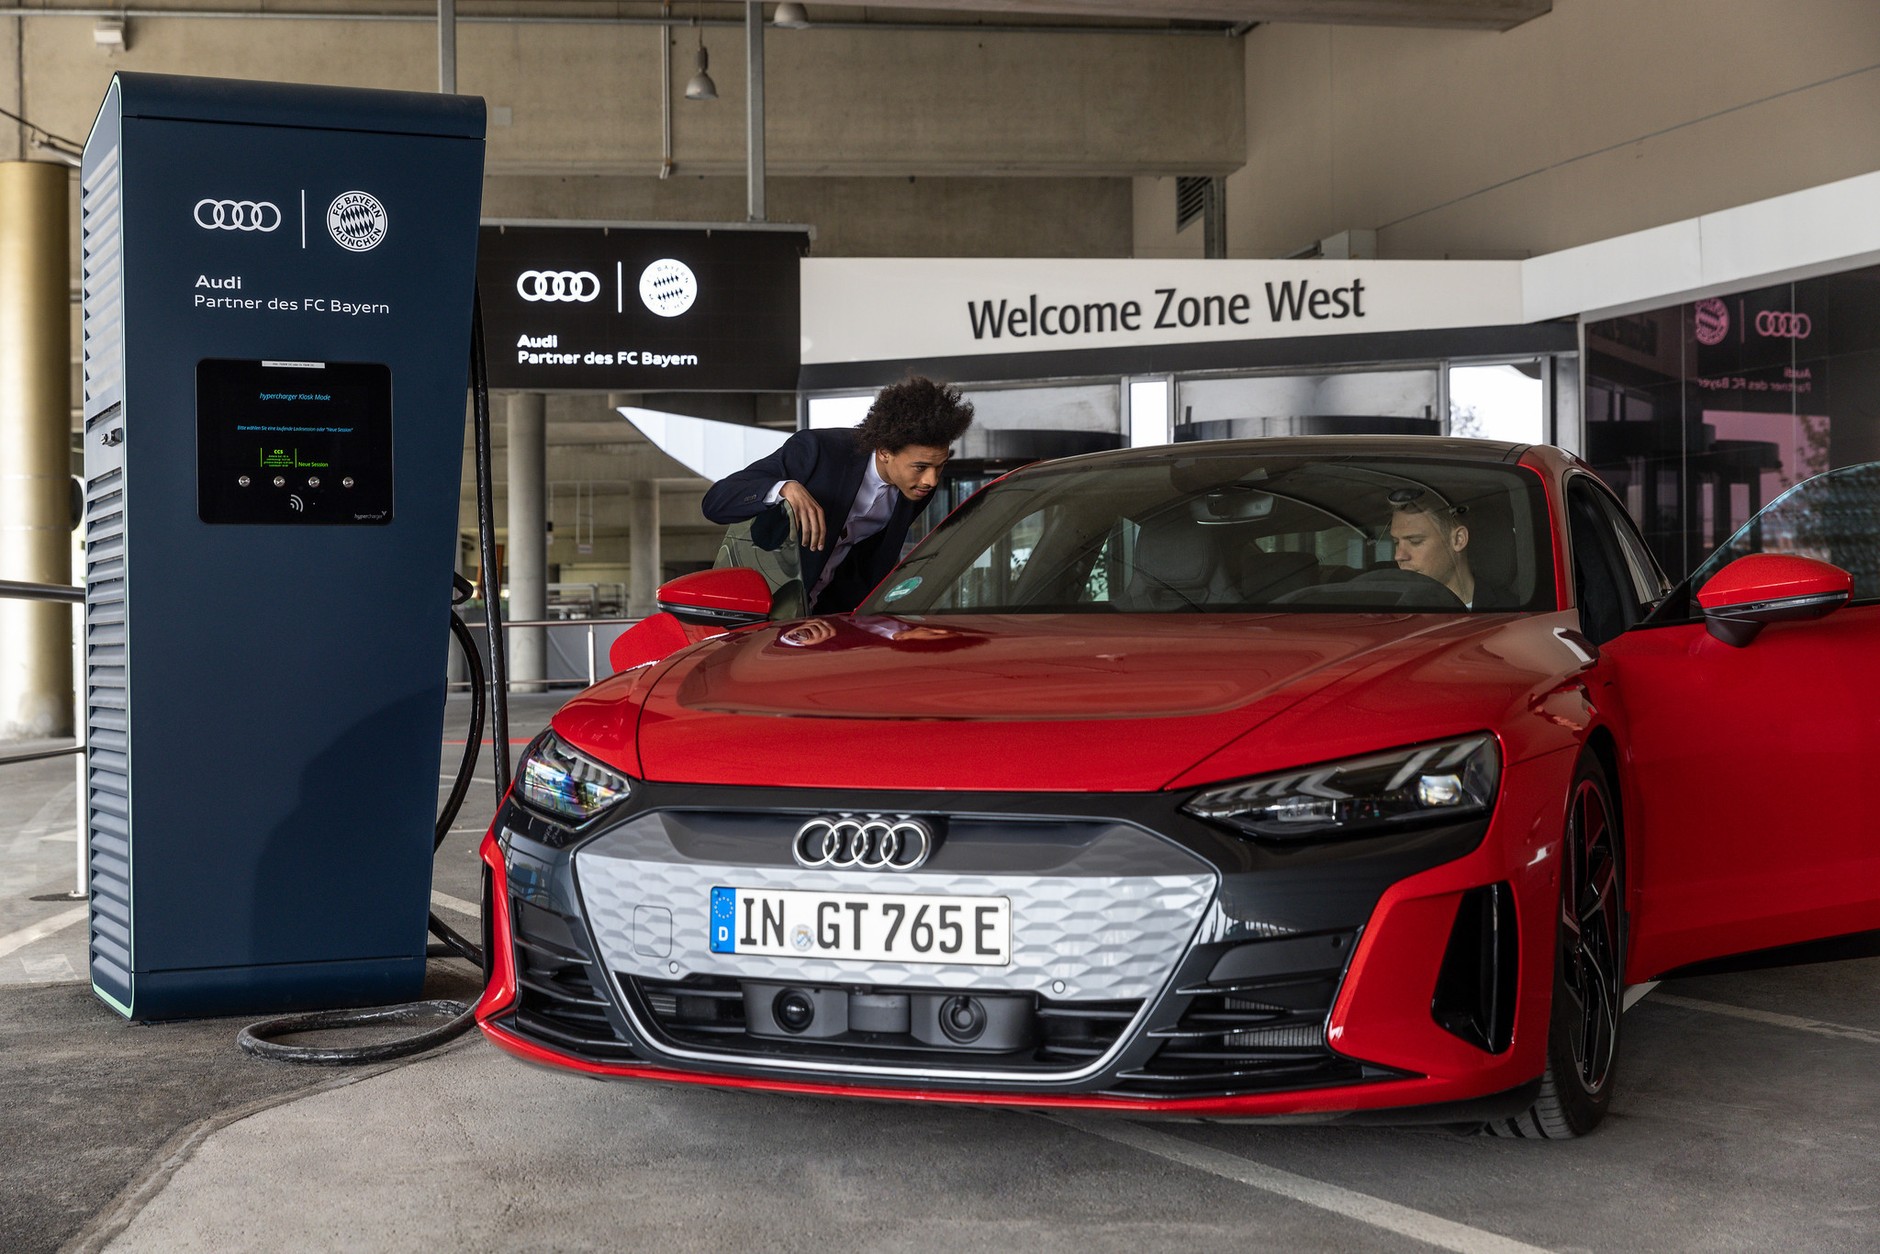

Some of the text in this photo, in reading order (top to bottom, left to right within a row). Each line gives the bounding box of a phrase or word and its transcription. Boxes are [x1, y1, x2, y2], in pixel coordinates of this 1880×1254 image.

[333, 195, 382, 218] FC BAYERN
[195, 274, 242, 289] Audi
[194, 294, 390, 316] Partner des FC Bayern
[968, 278, 1366, 339] Welcome Zone West
[517, 334, 558, 348] Audi
[518, 350, 698, 368] Partner des FC Bayern
[718, 926, 728, 941] D
[740, 897, 784, 947] IN
[817, 901, 868, 951] GT
